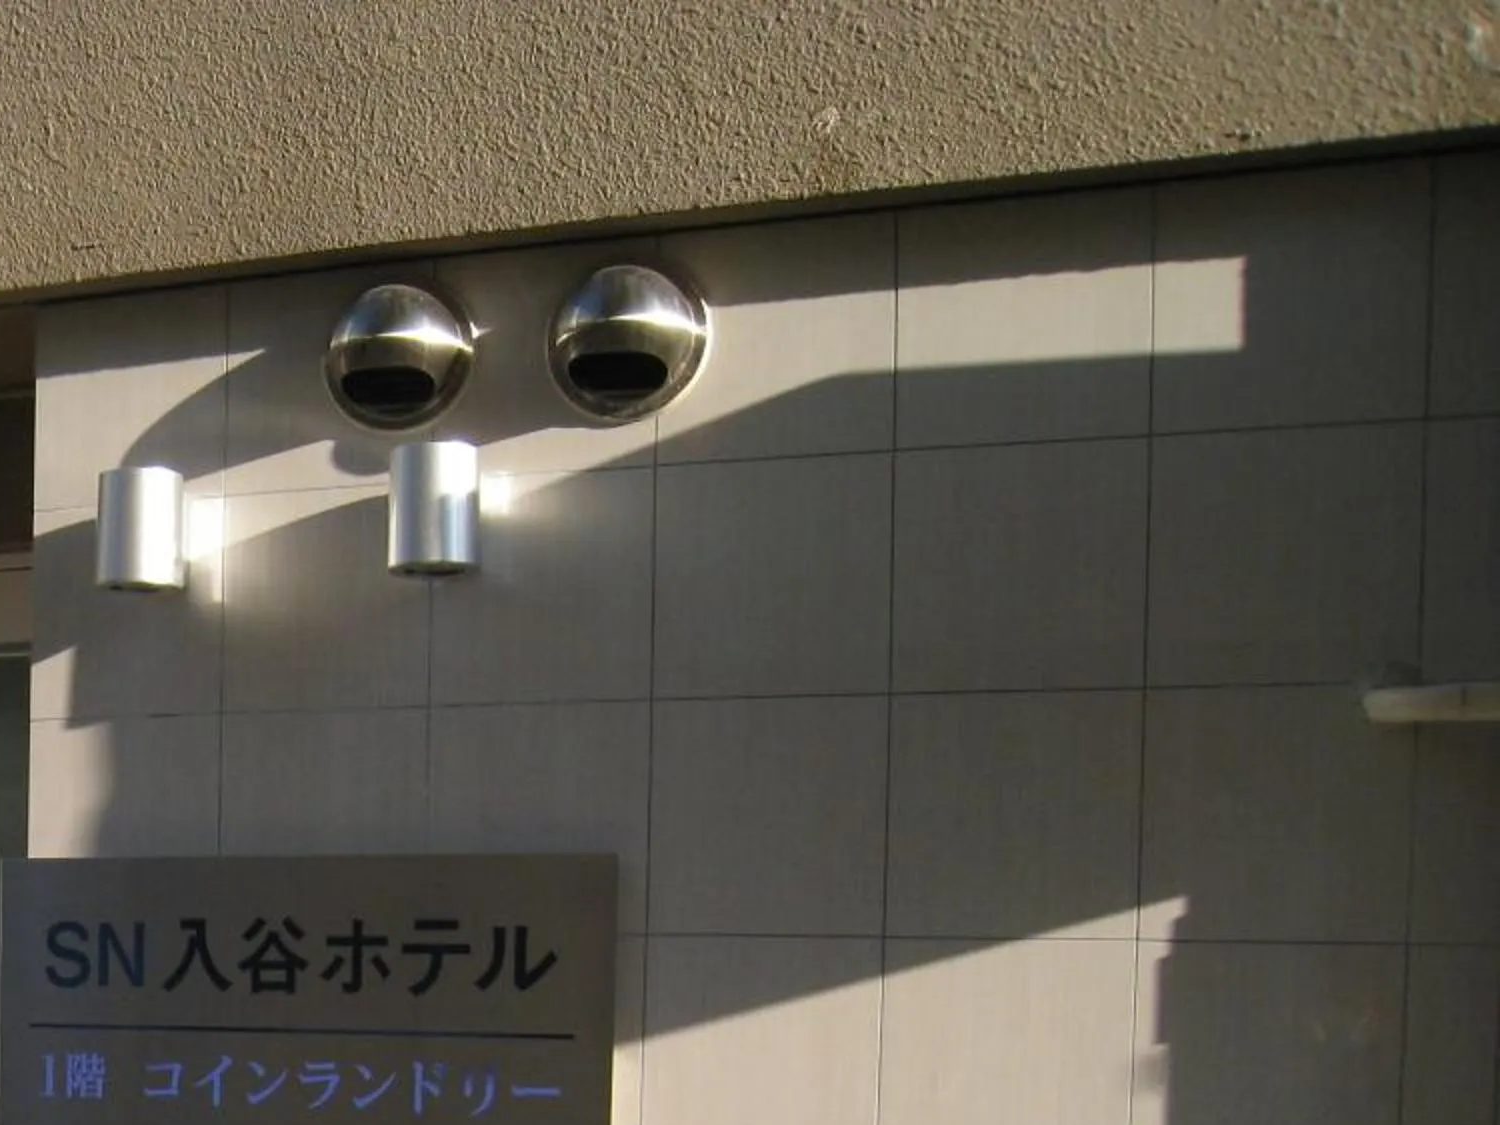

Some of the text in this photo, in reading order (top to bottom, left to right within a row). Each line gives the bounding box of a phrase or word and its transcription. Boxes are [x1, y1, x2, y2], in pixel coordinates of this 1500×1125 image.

[45, 917, 558, 996] SN入谷ホテル
[40, 1053, 561, 1117] 1階 コインランドリー
